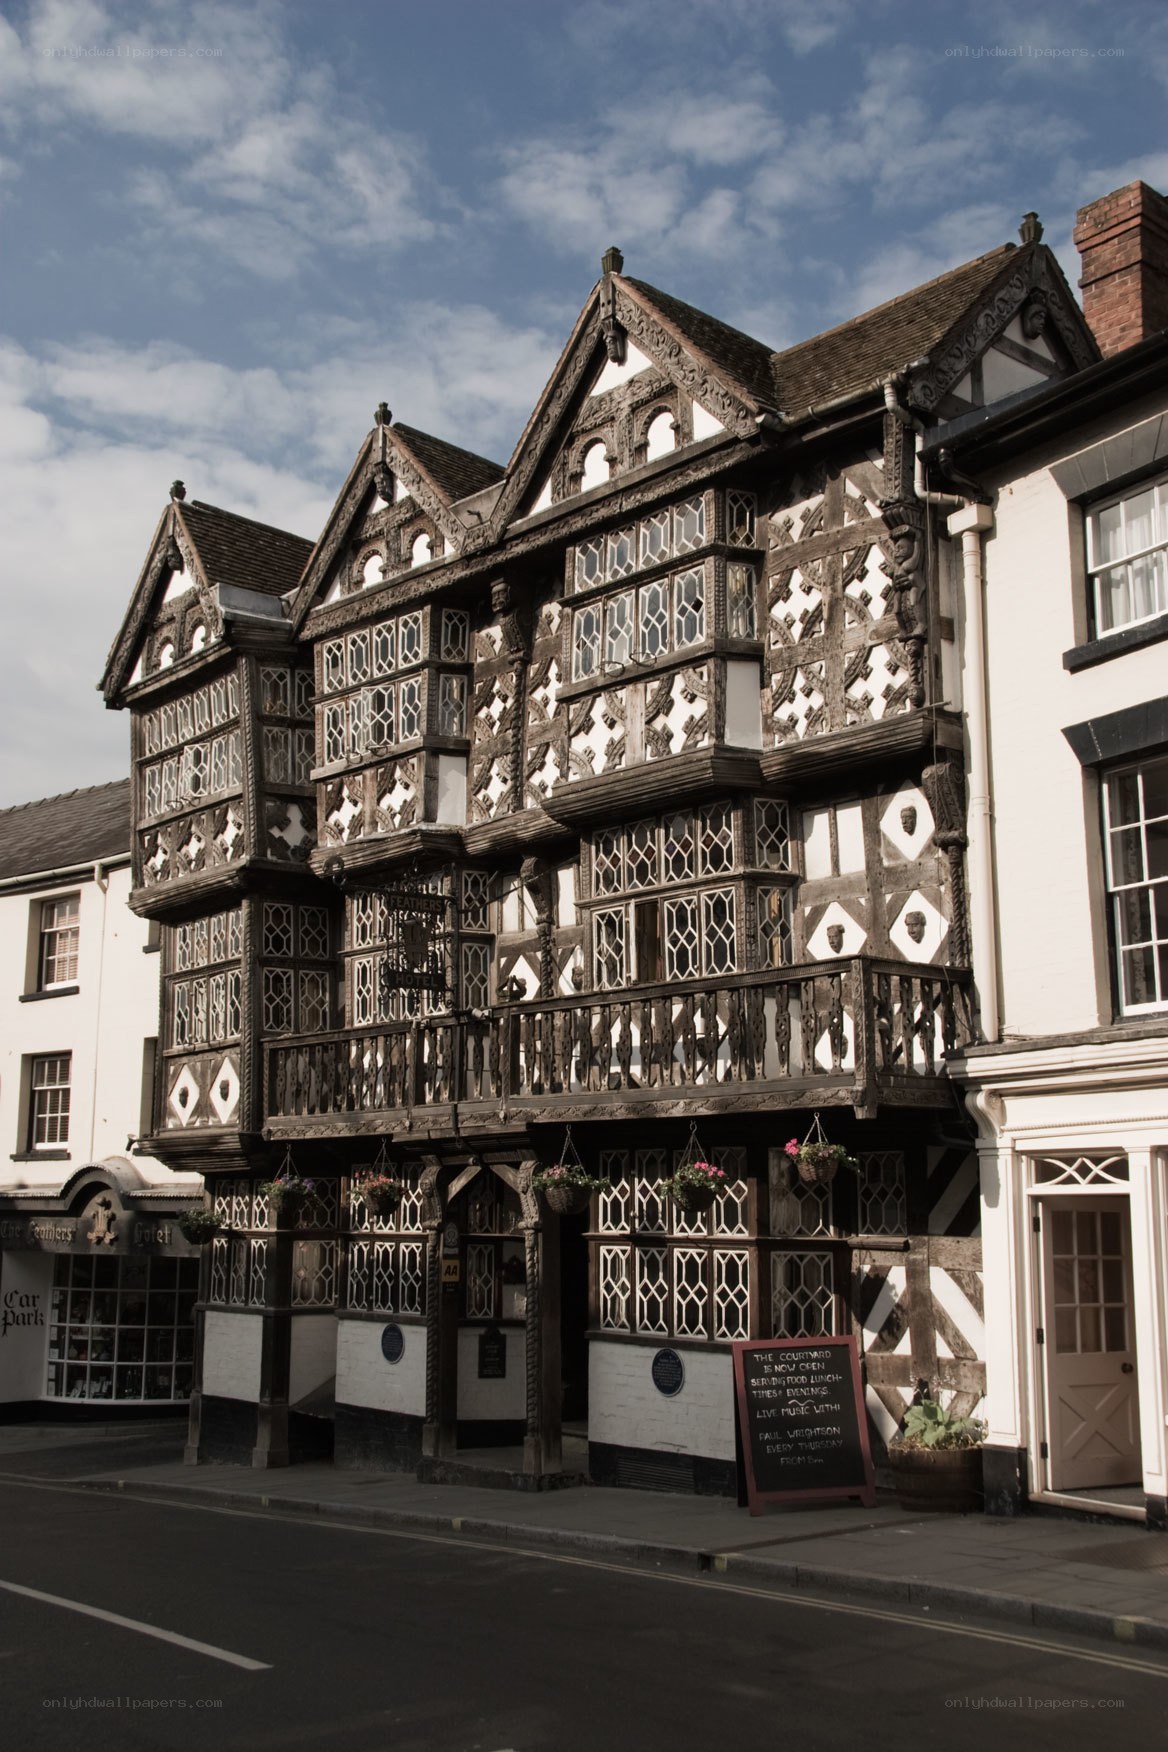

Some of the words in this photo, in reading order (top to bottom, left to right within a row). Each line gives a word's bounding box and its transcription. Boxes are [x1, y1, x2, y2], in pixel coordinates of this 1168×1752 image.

[390, 895, 442, 911] FEATHERS
[396, 973, 438, 987] HOTEL
[444, 1264, 458, 1277] AA
[4, 1289, 40, 1309] Car
[1, 1308, 45, 1337] Park
[753, 1353, 774, 1362] THE
[779, 1350, 832, 1361] COURTYARD
[763, 1365, 773, 1374] IS
[774, 1363, 796, 1373] NOW
[799, 1362, 825, 1371] OPEN
[750, 1376, 785, 1387] SERVING
[786, 1375, 808, 1384] FOOD
[756, 1408, 778, 1418] LIVE
[781, 1406, 810, 1416] MUSIC
[758, 1431, 783, 1441] PAUL
[786, 1426, 841, 1439] WRIGHTSON
[766, 1443, 794, 1454] EVERY
[798, 1439, 843, 1451] THURSDAY
[780, 1456, 806, 1466] FROM
